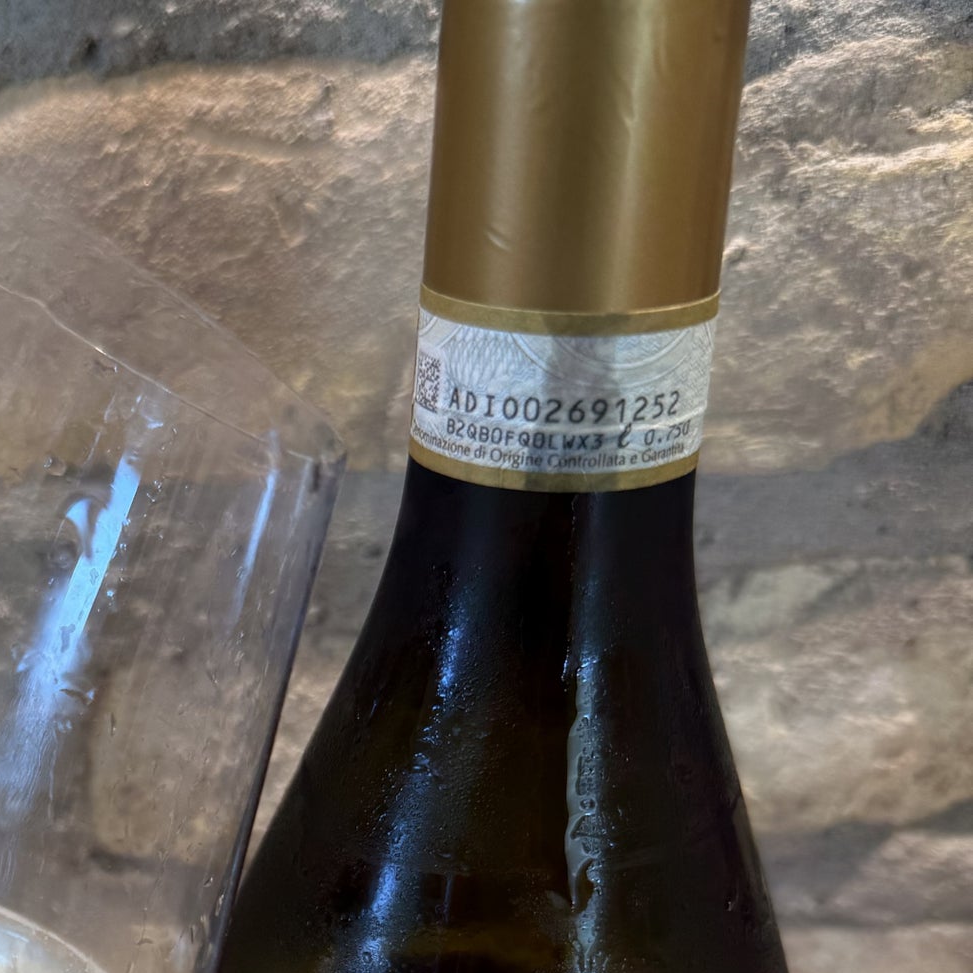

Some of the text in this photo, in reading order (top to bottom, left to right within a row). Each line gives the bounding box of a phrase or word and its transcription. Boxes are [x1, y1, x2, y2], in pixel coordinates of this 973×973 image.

[474, 445, 487, 459] di
[490, 448, 542, 469] Origine
[547, 453, 626, 469] Controllata
[630, 455, 638, 464] e
